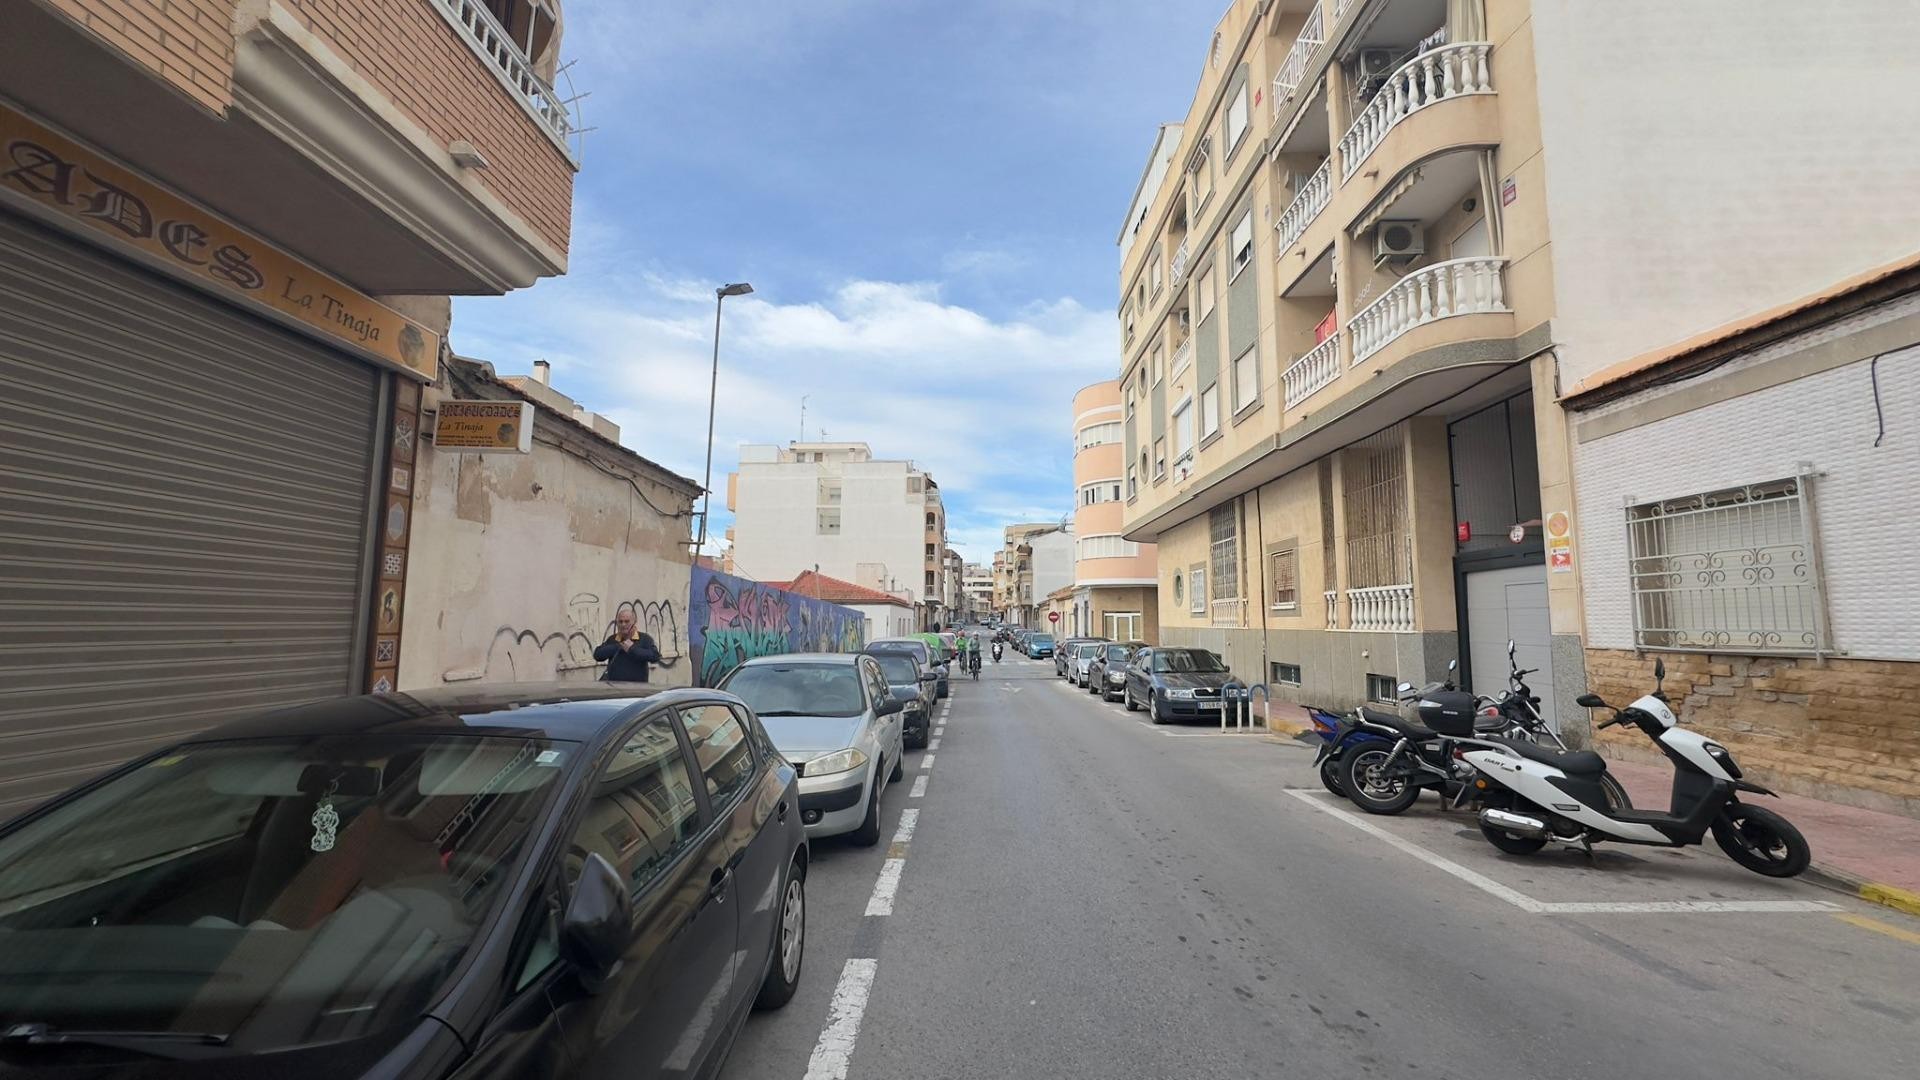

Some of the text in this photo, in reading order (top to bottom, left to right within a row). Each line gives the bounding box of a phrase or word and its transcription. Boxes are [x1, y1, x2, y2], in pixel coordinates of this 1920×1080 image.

[2, 139, 381, 342] ADES La Tinaja
[438, 421, 484, 433] La Tinaja
